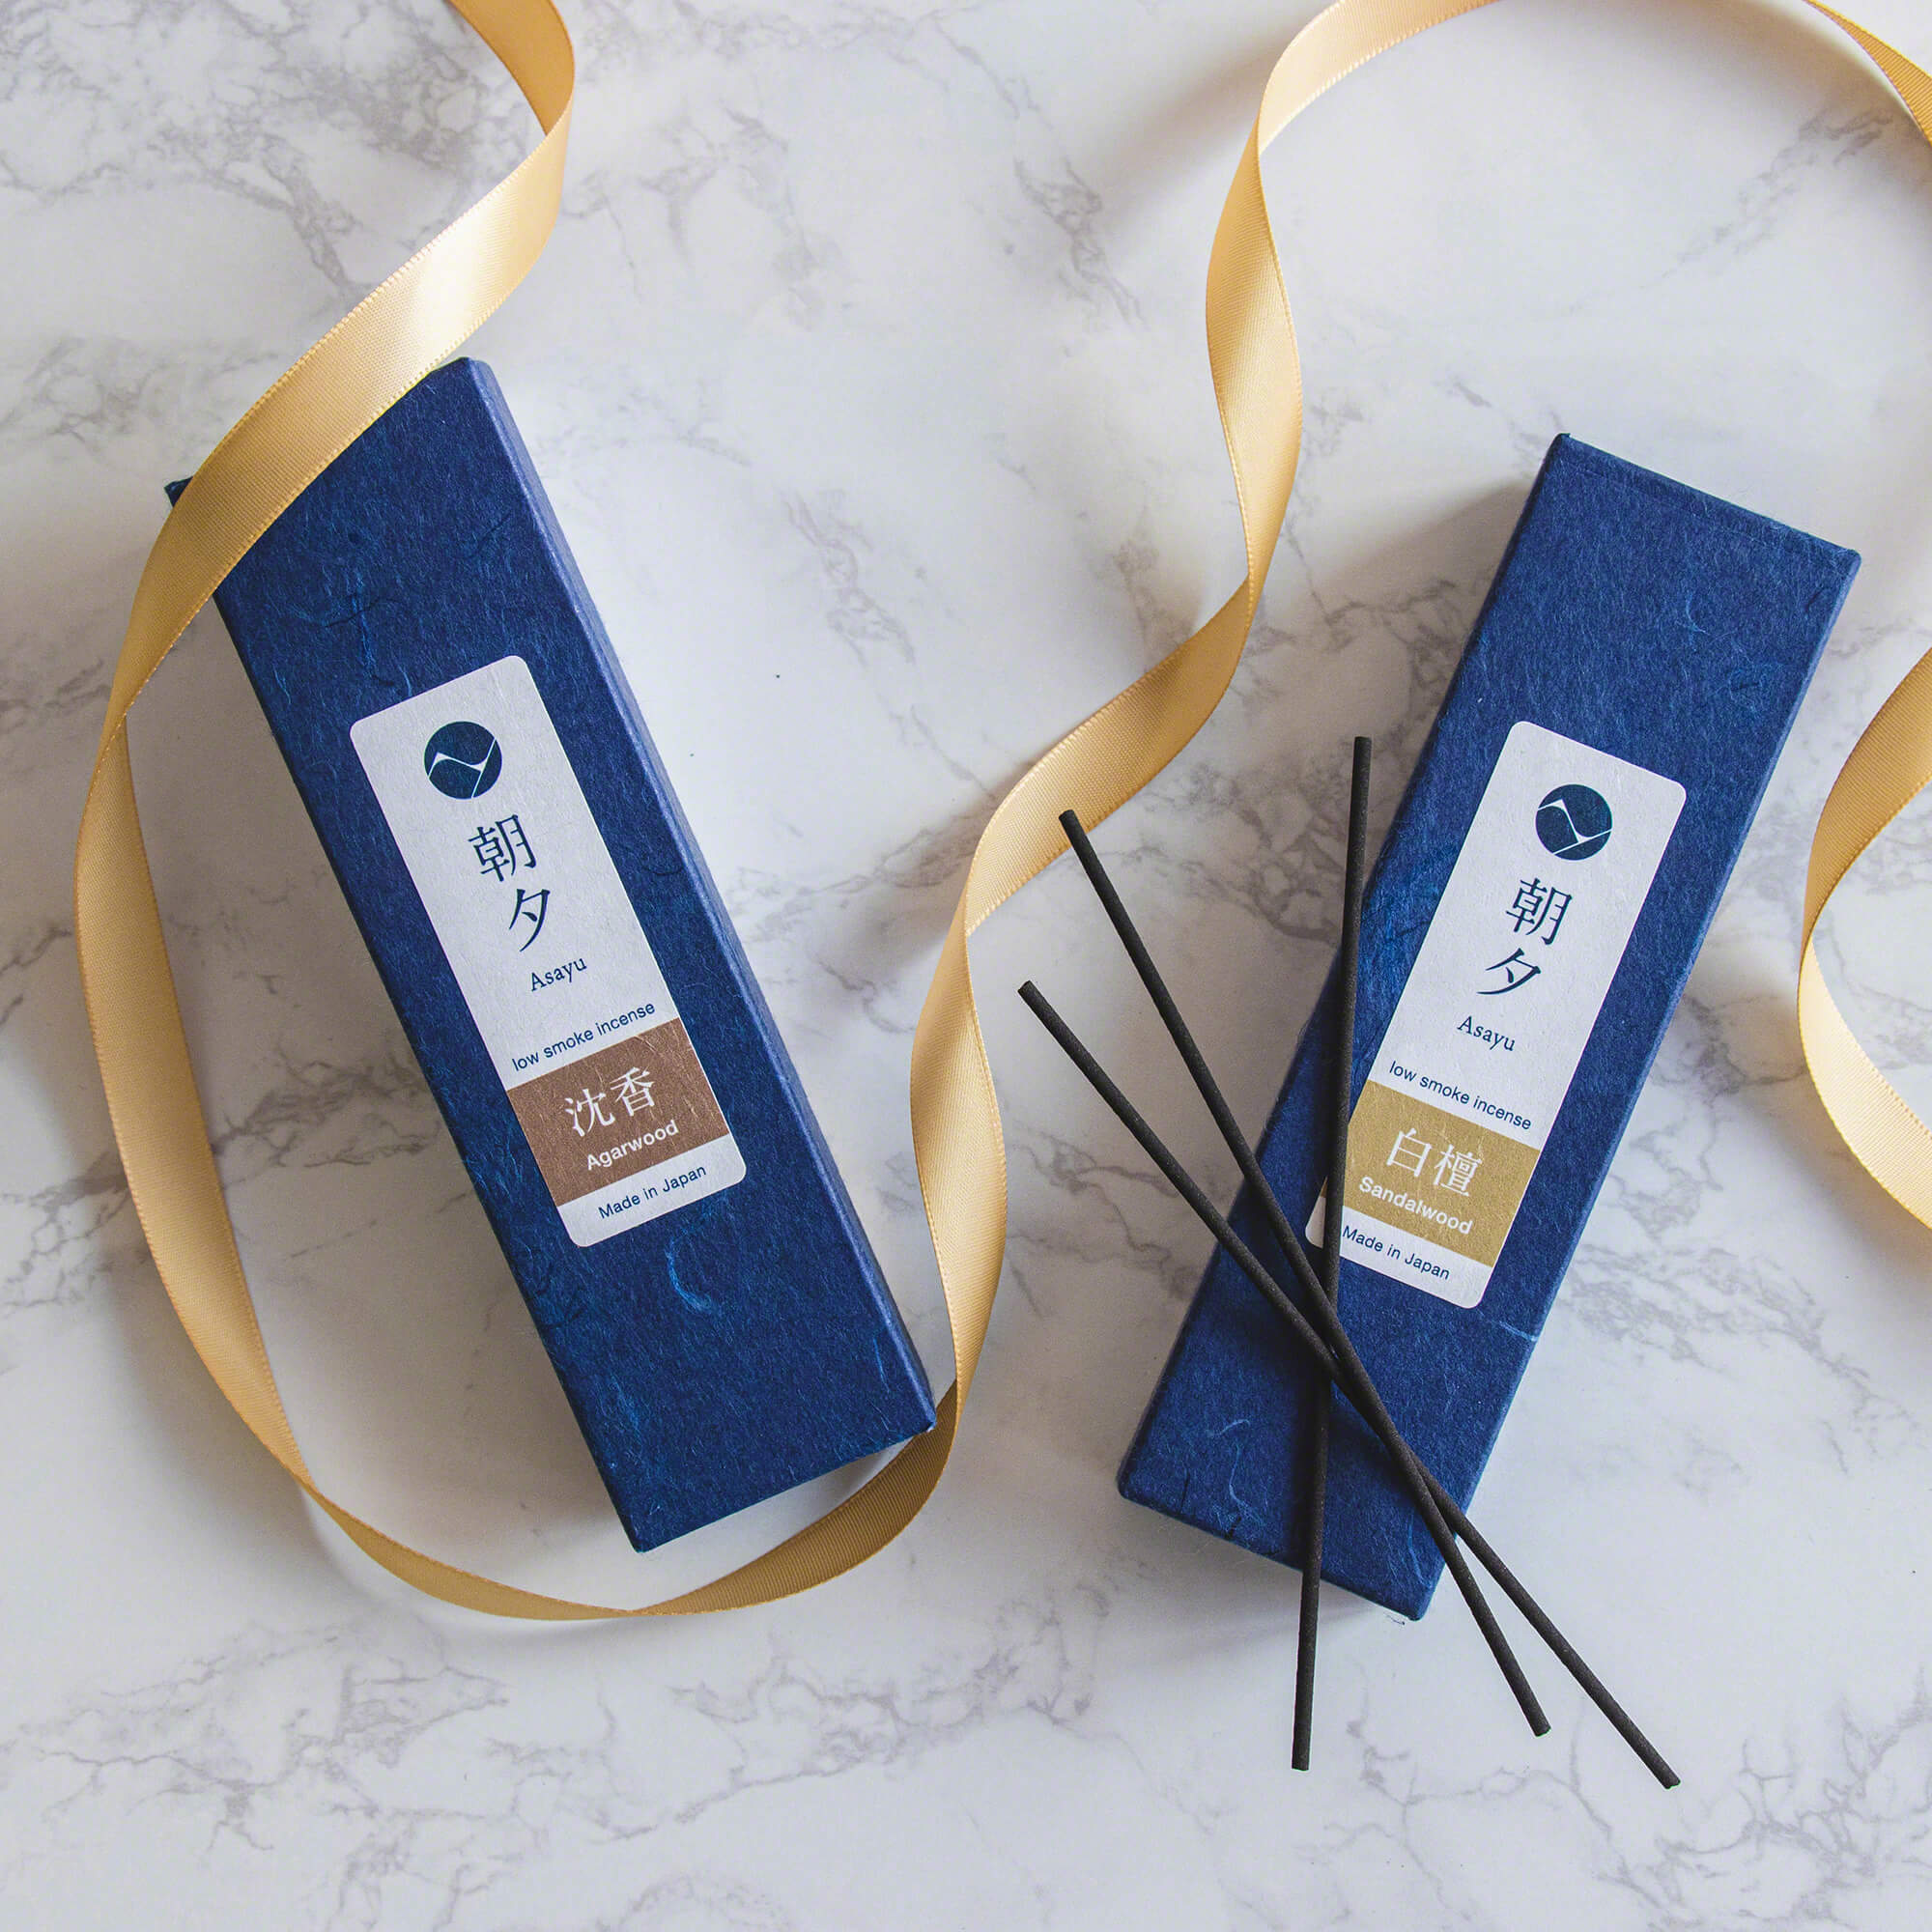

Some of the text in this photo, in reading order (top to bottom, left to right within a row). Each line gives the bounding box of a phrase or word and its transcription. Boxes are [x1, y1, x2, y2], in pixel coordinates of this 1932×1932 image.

[468, 814, 551, 952] 朝夕
[1476, 877, 1573, 995] 朝夕
[531, 957, 587, 992] Asayu
[512, 1003, 656, 1071] low smoke incense
[1457, 1015, 1516, 1052] Asayu
[564, 1066, 655, 1137] 沈香
[1389, 1061, 1531, 1130] low smoke incense
[586, 1120, 679, 1171] Agarwood
[1386, 1127, 1482, 1197] 白檀
[598, 1166, 706, 1219] Made in Japan
[1358, 1176, 1473, 1235] Sandalwood
[1342, 1225, 1450, 1280] Made in Japan
